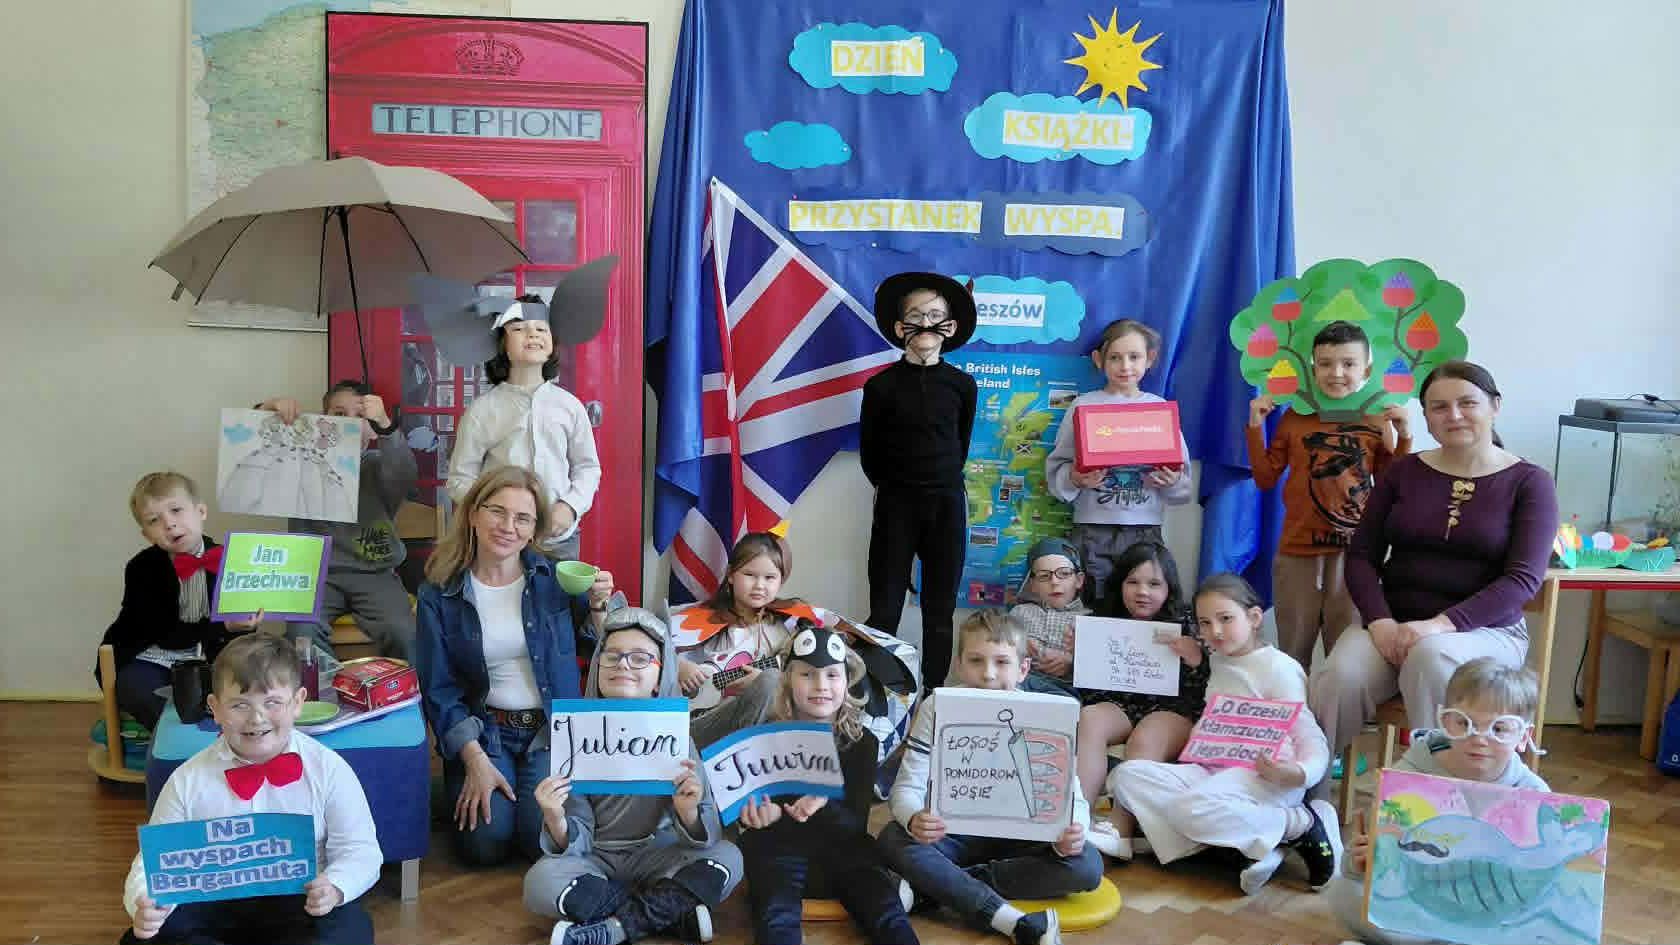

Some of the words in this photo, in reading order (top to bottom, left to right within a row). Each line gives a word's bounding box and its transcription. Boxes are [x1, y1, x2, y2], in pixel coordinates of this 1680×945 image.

[379, 106, 595, 138] TELEPHONE
[1006, 112, 1132, 151] KSIĄŻKI-
[792, 202, 980, 229] PRZYSTANEK
[976, 299, 1042, 319] eszów
[966, 362, 1007, 375] British
[1012, 364, 1040, 376] Isles
[977, 378, 1010, 389] eland
[254, 543, 283, 563] Jan
[223, 569, 310, 590] Brzechwa
[554, 715, 680, 778] Julian
[947, 731, 1001, 752] ŁOSOŚ
[714, 744, 840, 791] Tuwim
[950, 784, 993, 800] SOSIE
[211, 819, 251, 839] Na
[161, 838, 287, 869] wyspach
[152, 862, 307, 891] Bergamuta
